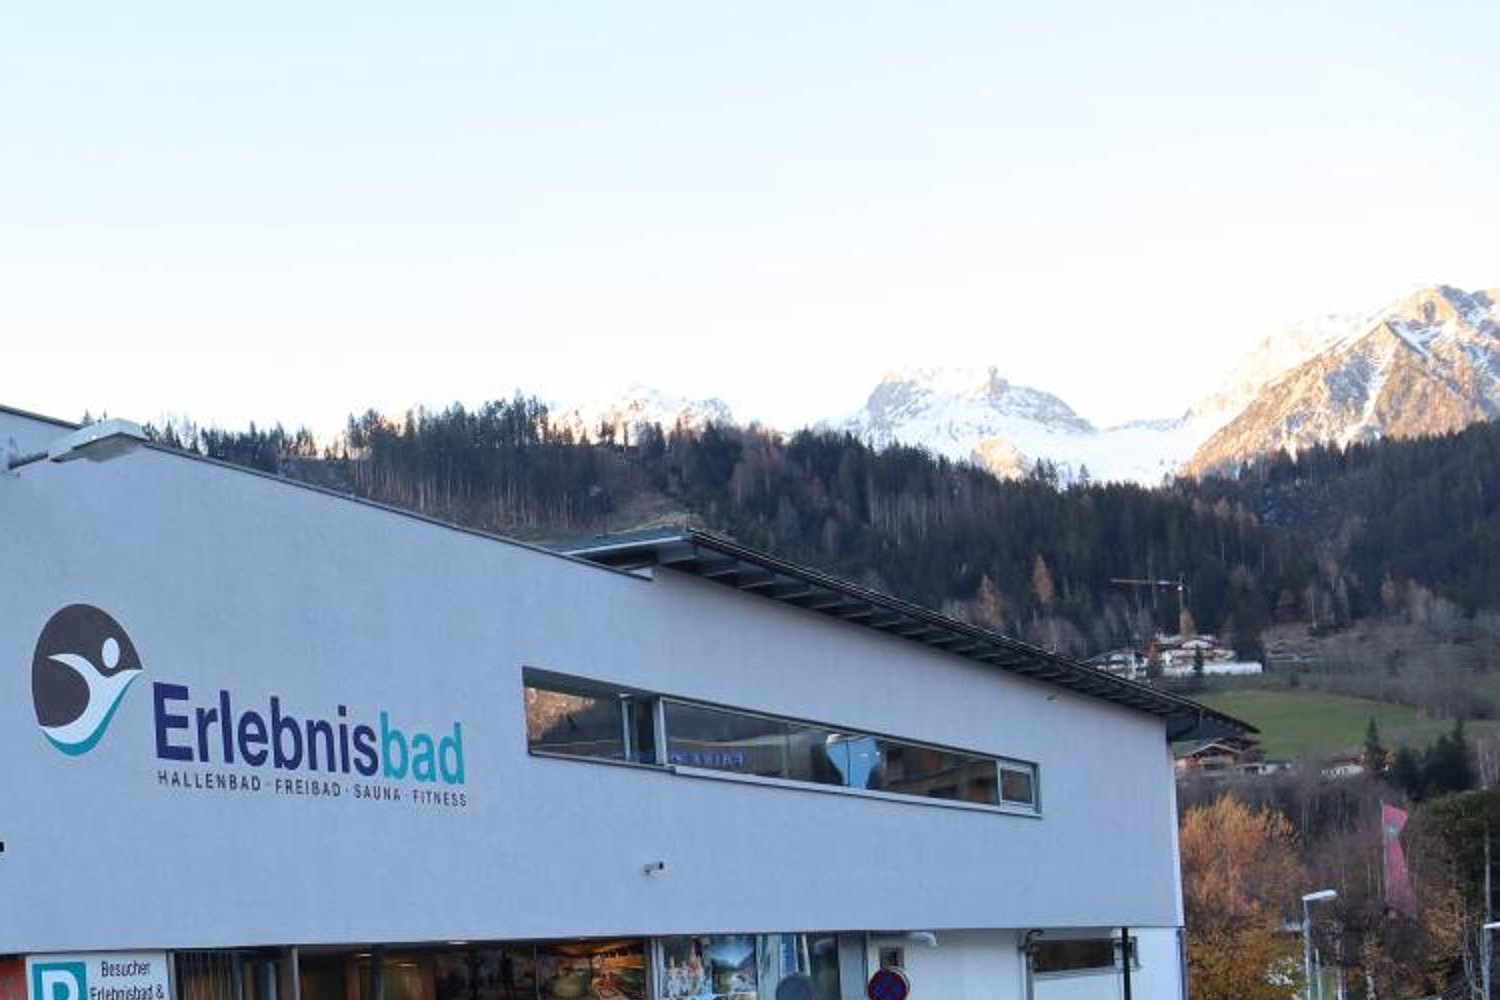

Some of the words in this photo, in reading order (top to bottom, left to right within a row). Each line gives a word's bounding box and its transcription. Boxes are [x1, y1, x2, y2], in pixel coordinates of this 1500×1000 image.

[153, 680, 466, 785] Erlebnisbad
[157, 769, 261, 791] HALLENBAD
[275, 778, 341, 797] FREIBAD
[355, 783, 401, 801] SAUNA
[412, 788, 468, 807] FITNESS
[101, 960, 152, 977] Besucher
